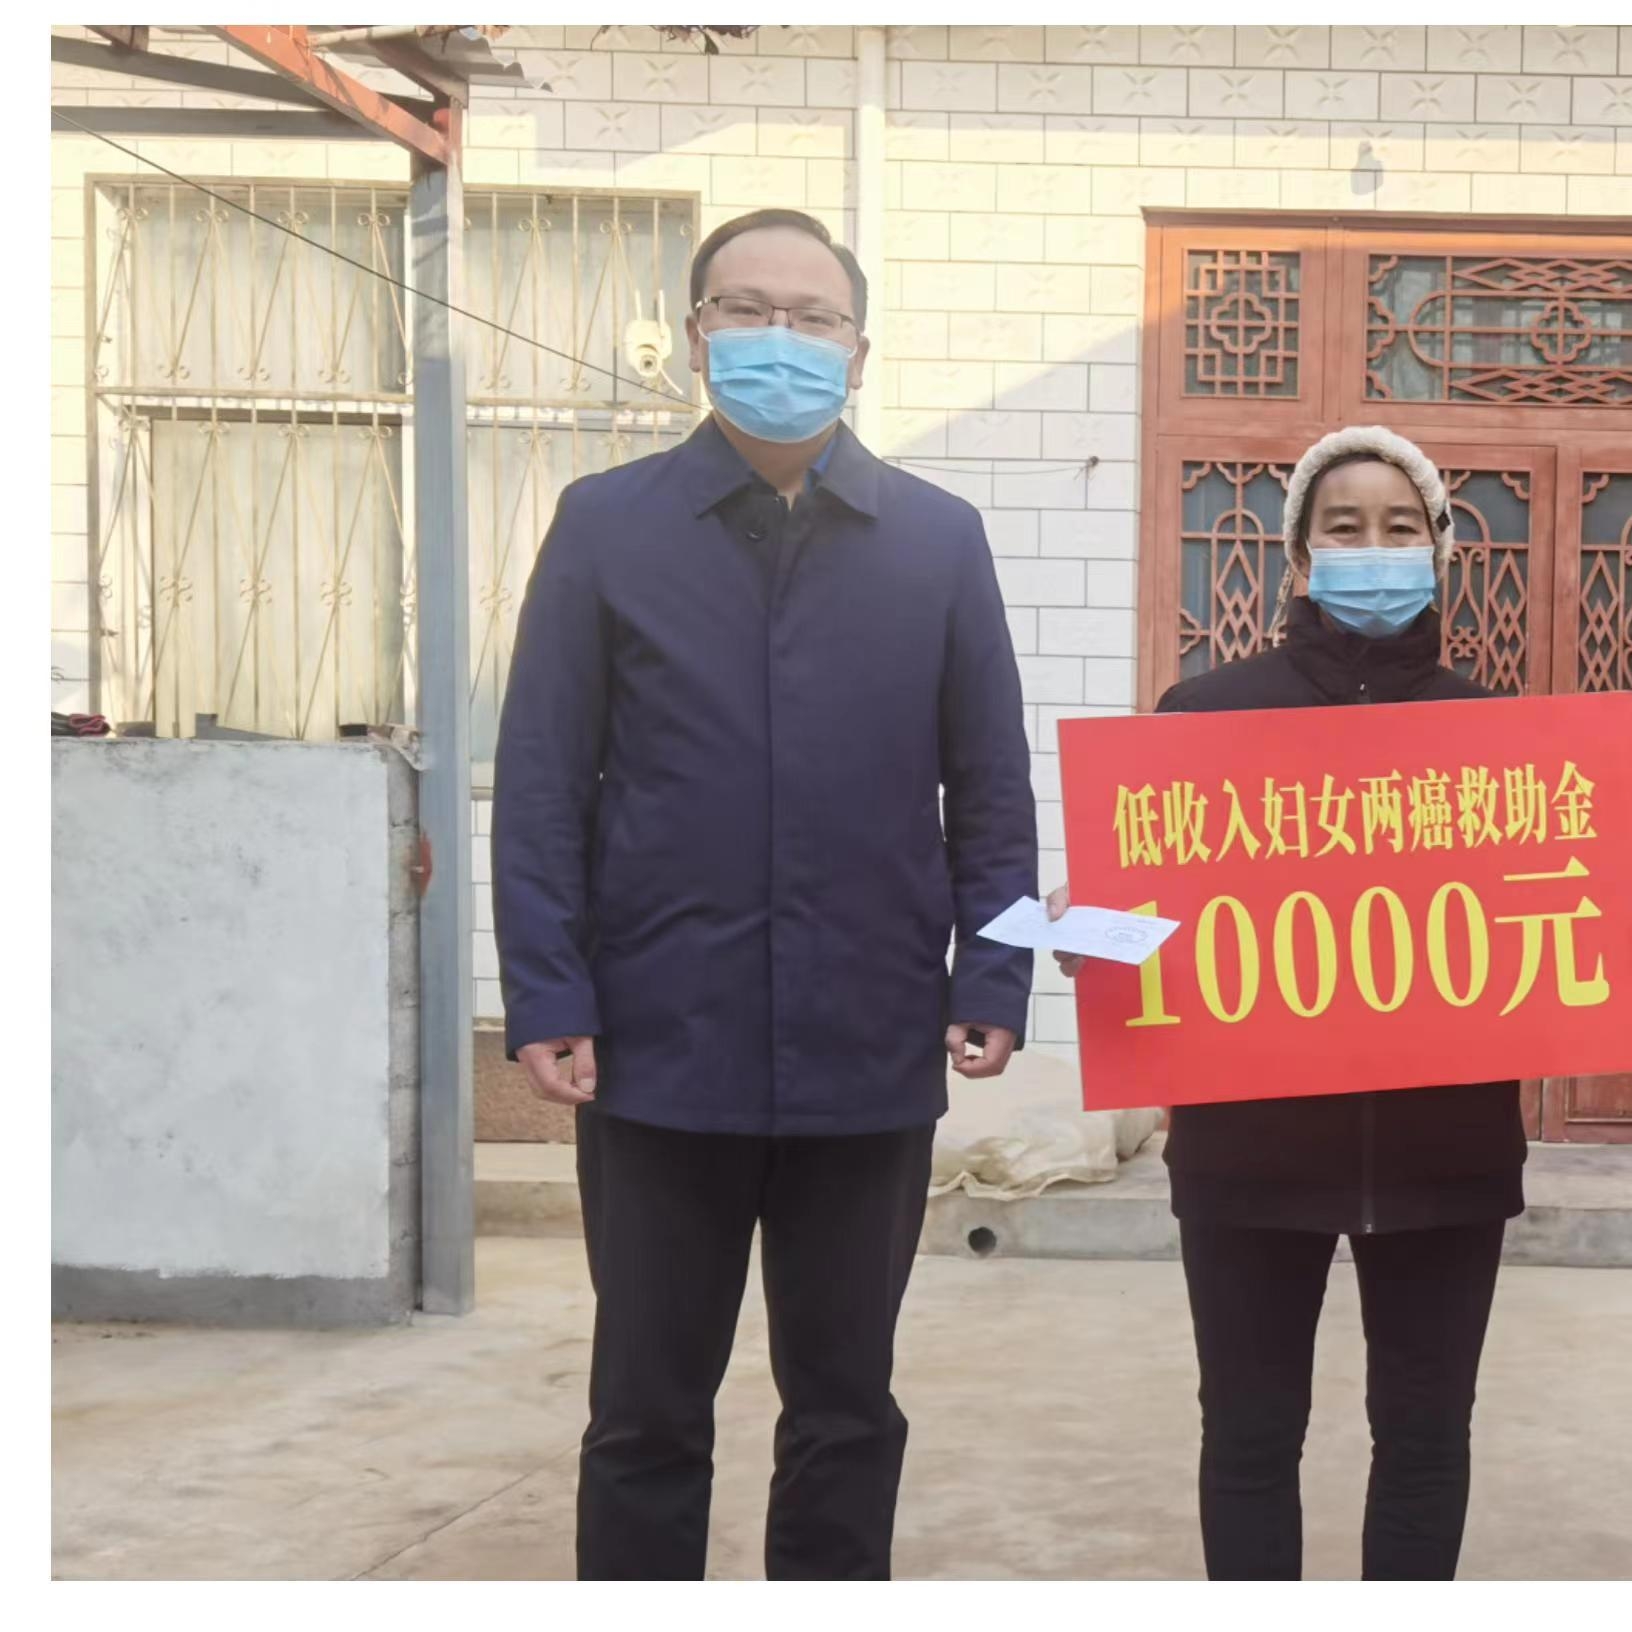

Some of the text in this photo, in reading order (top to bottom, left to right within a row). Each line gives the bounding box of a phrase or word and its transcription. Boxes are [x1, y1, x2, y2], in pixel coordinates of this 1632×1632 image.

[1112, 760, 1598, 868] 低收入妇女两癌救助金
[1125, 856, 1610, 1027] 10000元
